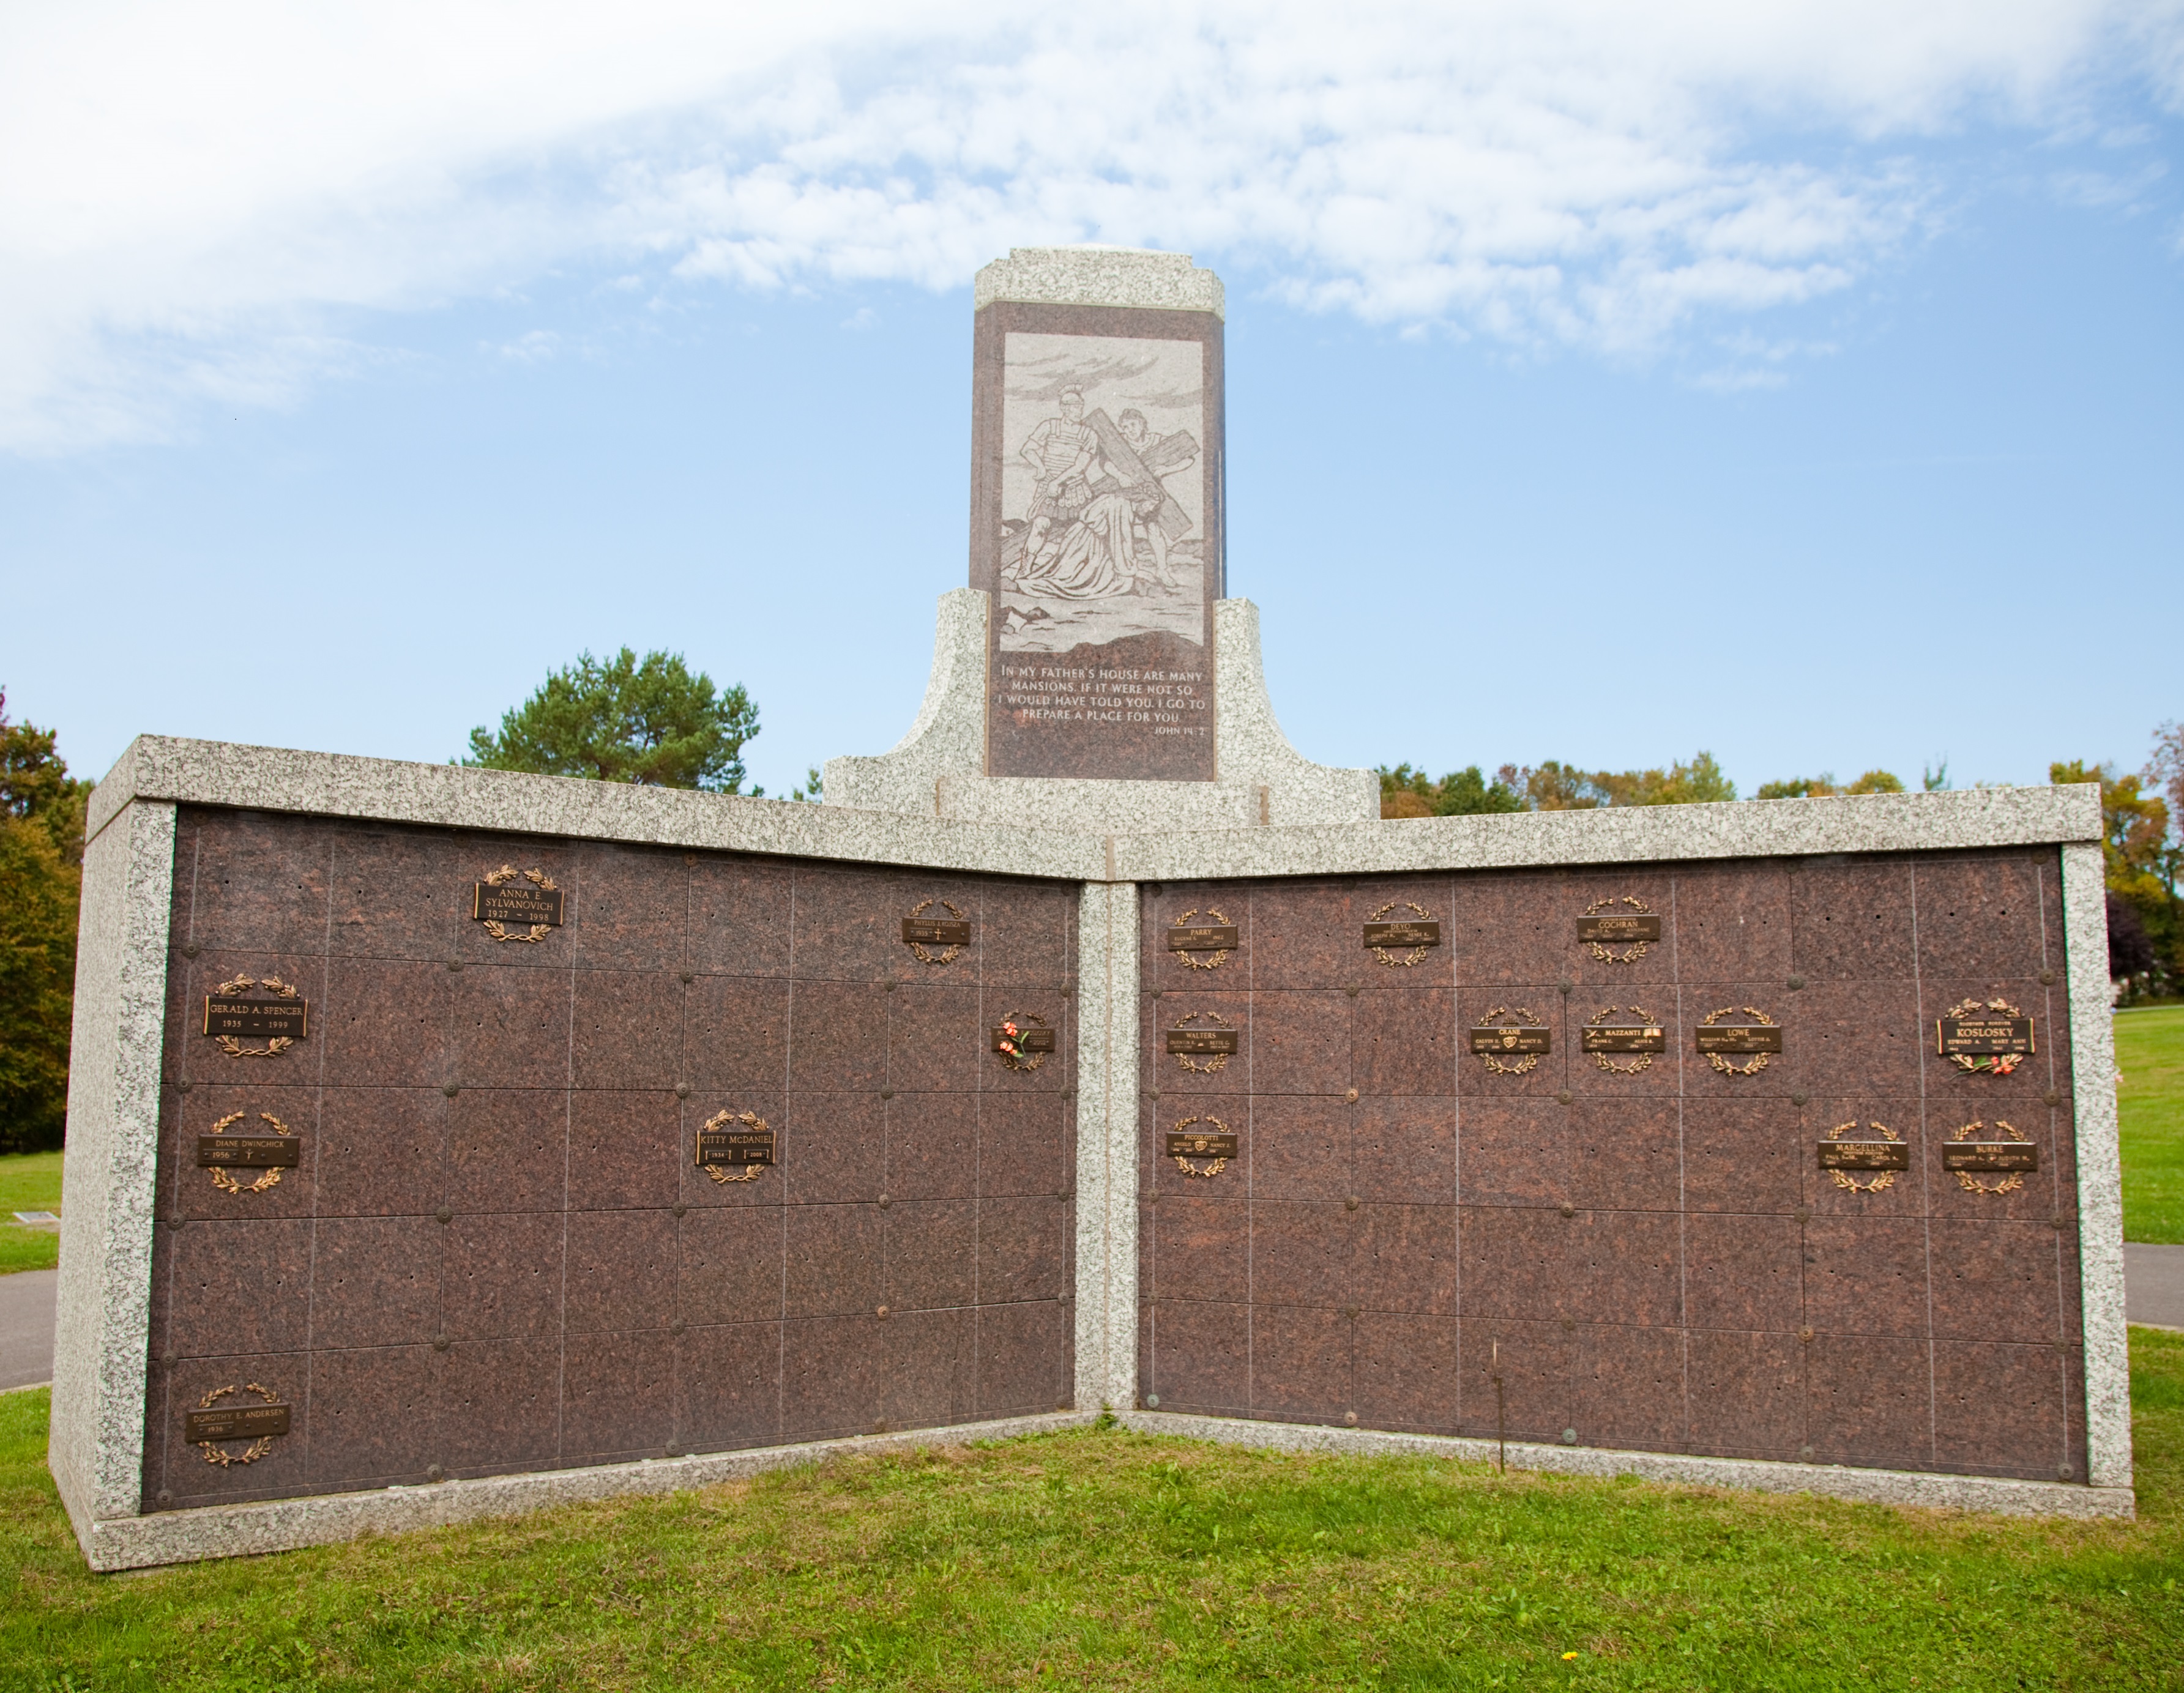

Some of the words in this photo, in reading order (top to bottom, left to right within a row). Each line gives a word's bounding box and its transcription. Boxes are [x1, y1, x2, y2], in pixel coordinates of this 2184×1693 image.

[1019, 667, 1037, 677] MY
[1042, 668, 1095, 679] FATHER'S
[1100, 669, 1139, 680] HOUSE
[1144, 671, 1164, 680] ARE
[1170, 672, 1202, 682] MANY
[1012, 681, 1076, 692] MANSIONS.
[1081, 683, 1090, 693] IF
[1096, 683, 1107, 693] IT
[1111, 683, 1142, 694] WERE
[1147, 685, 1172, 694] NOT
[1177, 685, 1193, 695] SO
[999, 694, 1001, 703] I
[1007, 695, 1050, 705] WOULD
[1056, 696, 1086, 706] HAVE
[1090, 697, 1121, 707] TOLD
[1126, 698, 1154, 708] YOU.
[1158, 699, 1161, 708] I
[1166, 699, 1185, 709] GO
[1189, 700, 1206, 710] TO
[1023, 709, 1070, 720] PREPARE
[1075, 711, 1082, 720] A
[1087, 711, 1122, 721] PLACE
[1127, 712, 1149, 722] FOR
[499, 889, 529, 899] ANNA
[485, 898, 553, 911] SYLVANOVICH
[211, 1005, 248, 1013] GERALD
[1957, 1029, 2013, 1037] KOSLOSKY
[194, 1413, 232, 1423] DOROTHY
[245, 1409, 284, 1418] ANDERSEN
